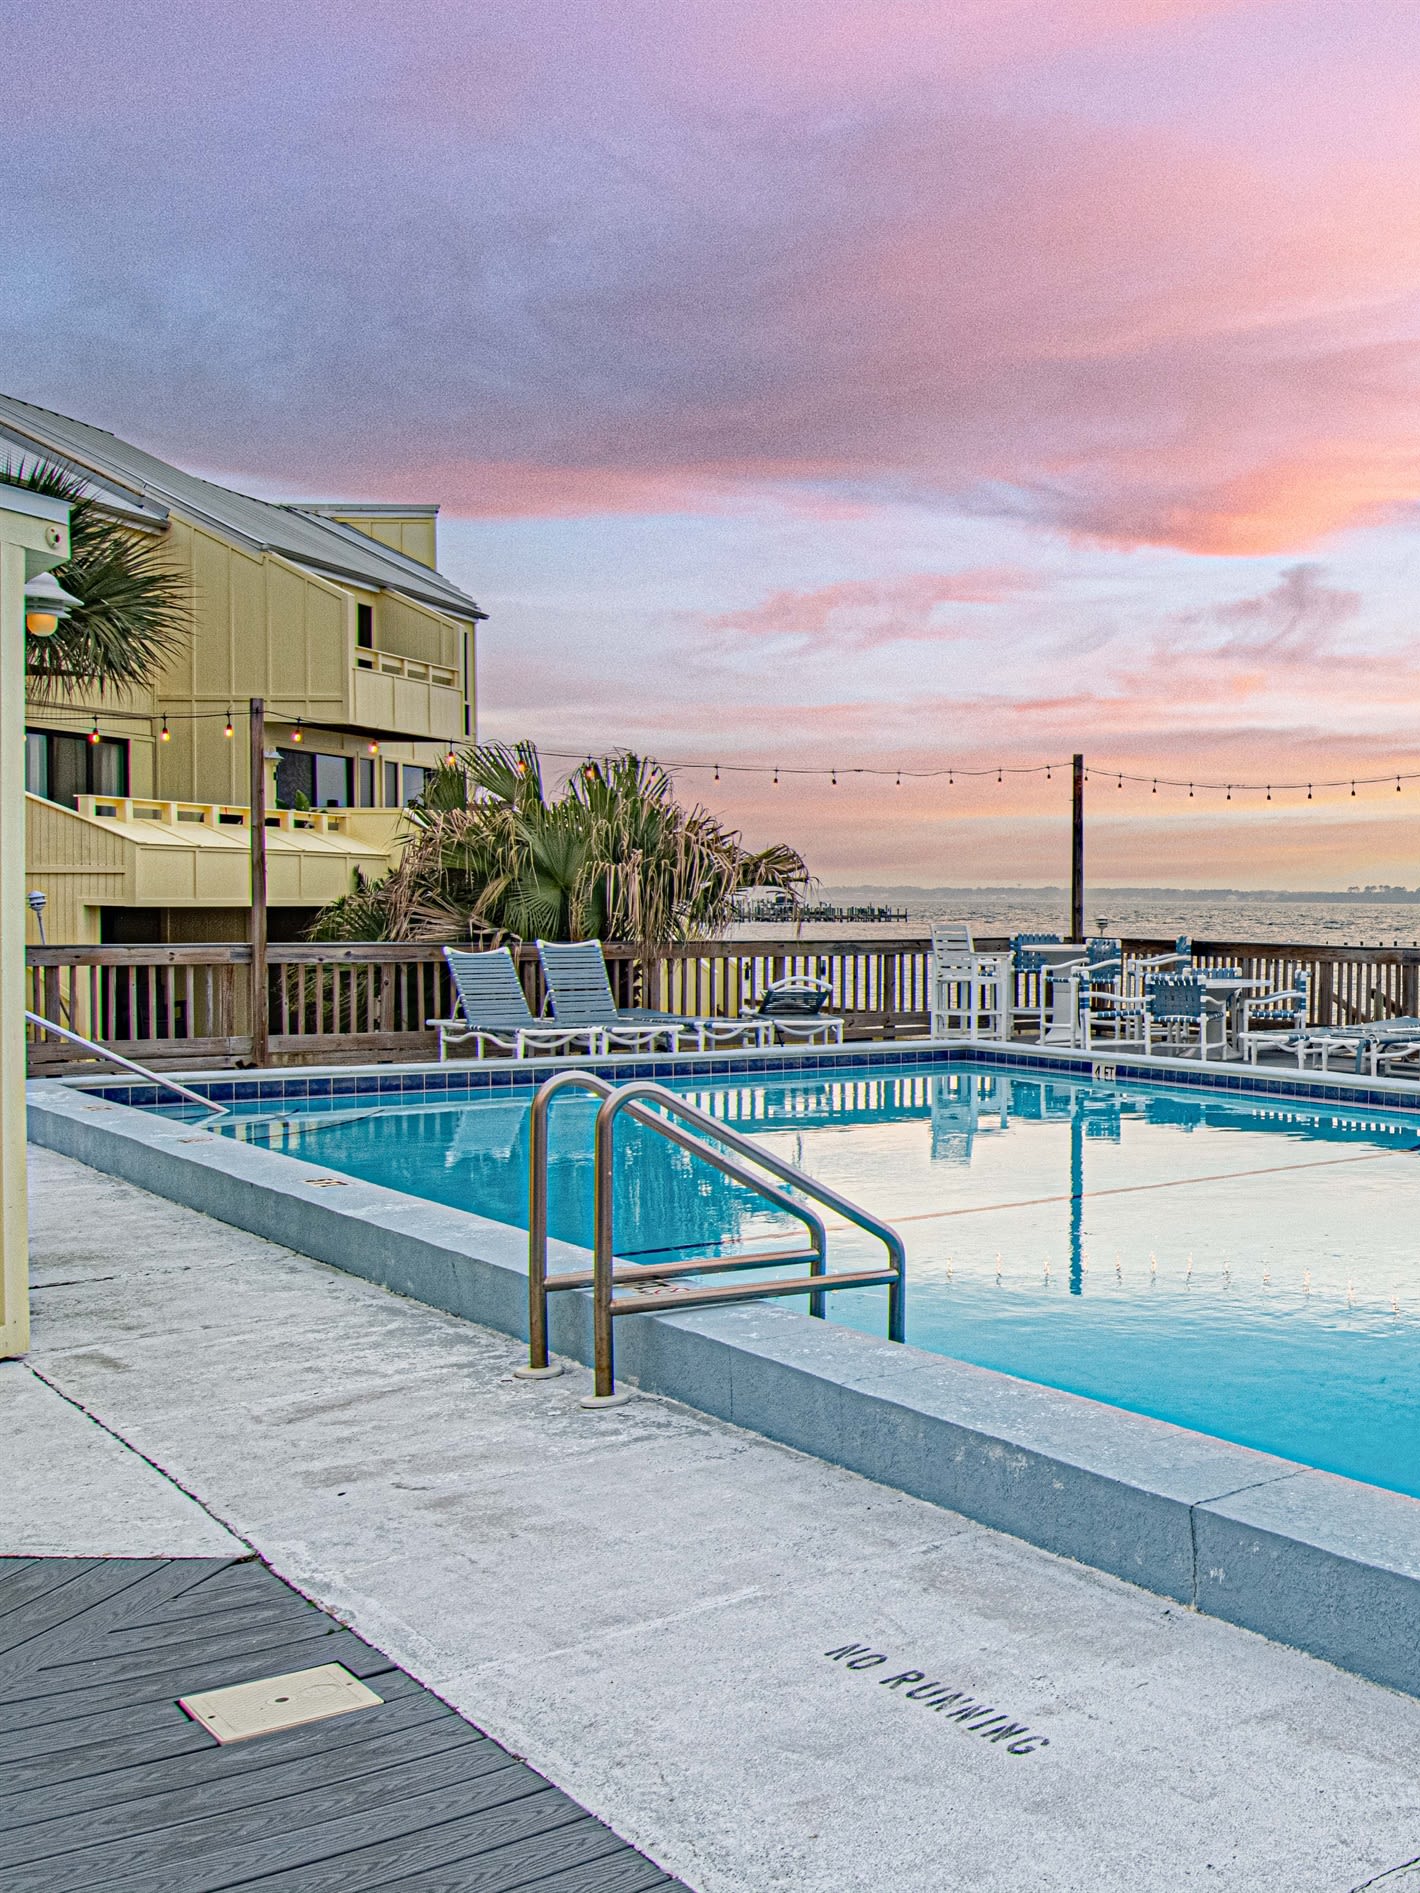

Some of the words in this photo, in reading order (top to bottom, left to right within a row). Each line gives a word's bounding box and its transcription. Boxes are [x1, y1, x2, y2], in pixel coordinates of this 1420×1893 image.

[1104, 1066, 1114, 1076] FT
[824, 1643, 888, 1671] NO
[878, 1669, 1050, 1756] RUNNING
